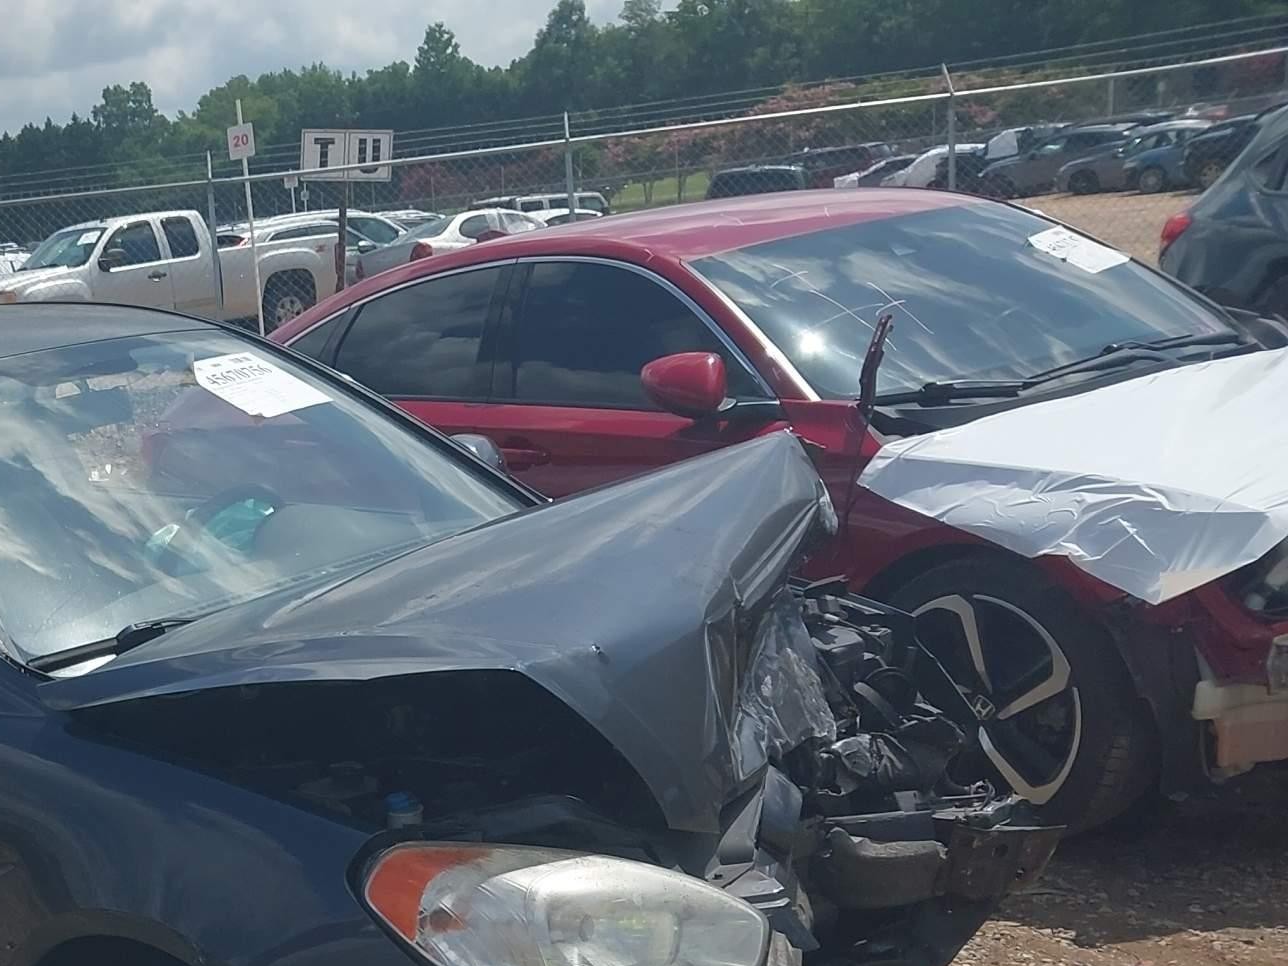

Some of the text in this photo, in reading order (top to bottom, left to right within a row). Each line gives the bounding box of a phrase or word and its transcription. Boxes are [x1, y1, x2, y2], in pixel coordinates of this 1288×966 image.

[232, 133, 249, 148] 20
[314, 137, 381, 174] T U
